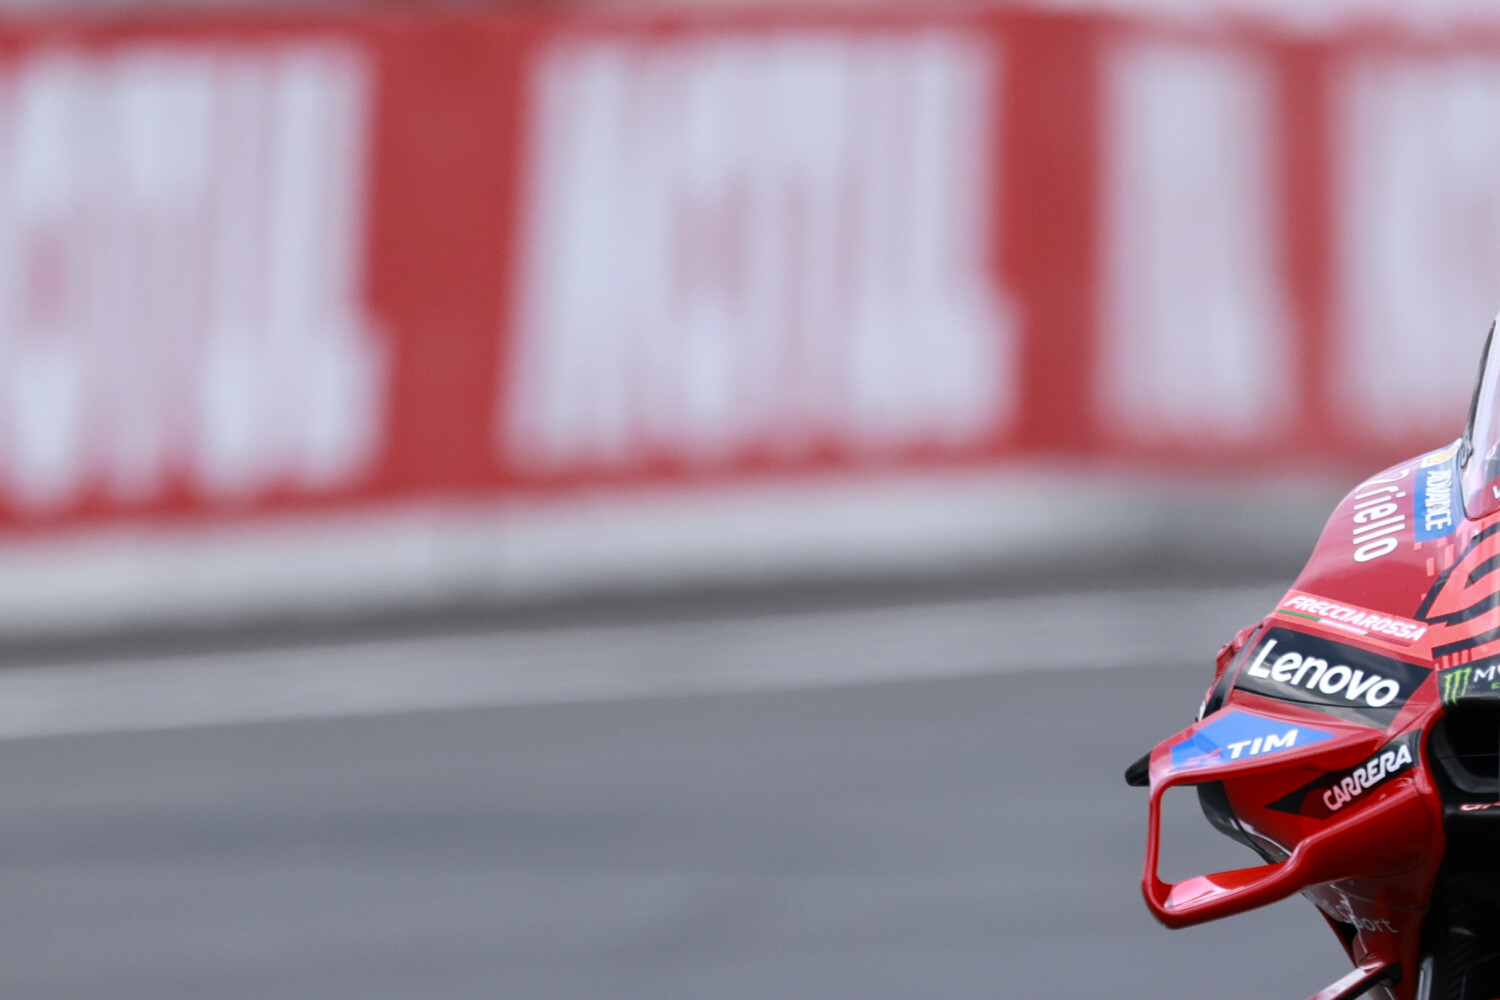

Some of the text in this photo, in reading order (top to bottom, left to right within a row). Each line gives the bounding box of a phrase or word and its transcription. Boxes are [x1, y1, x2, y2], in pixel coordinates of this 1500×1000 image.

[1353, 485, 1406, 562] riello
[1425, 470, 1453, 531] ADVANCE
[1284, 596, 1427, 641] FRECCIAROSSA
[1248, 639, 1400, 708] Lenovo
[1227, 729, 1299, 760] TIM
[1323, 744, 1413, 811] CARRERA
